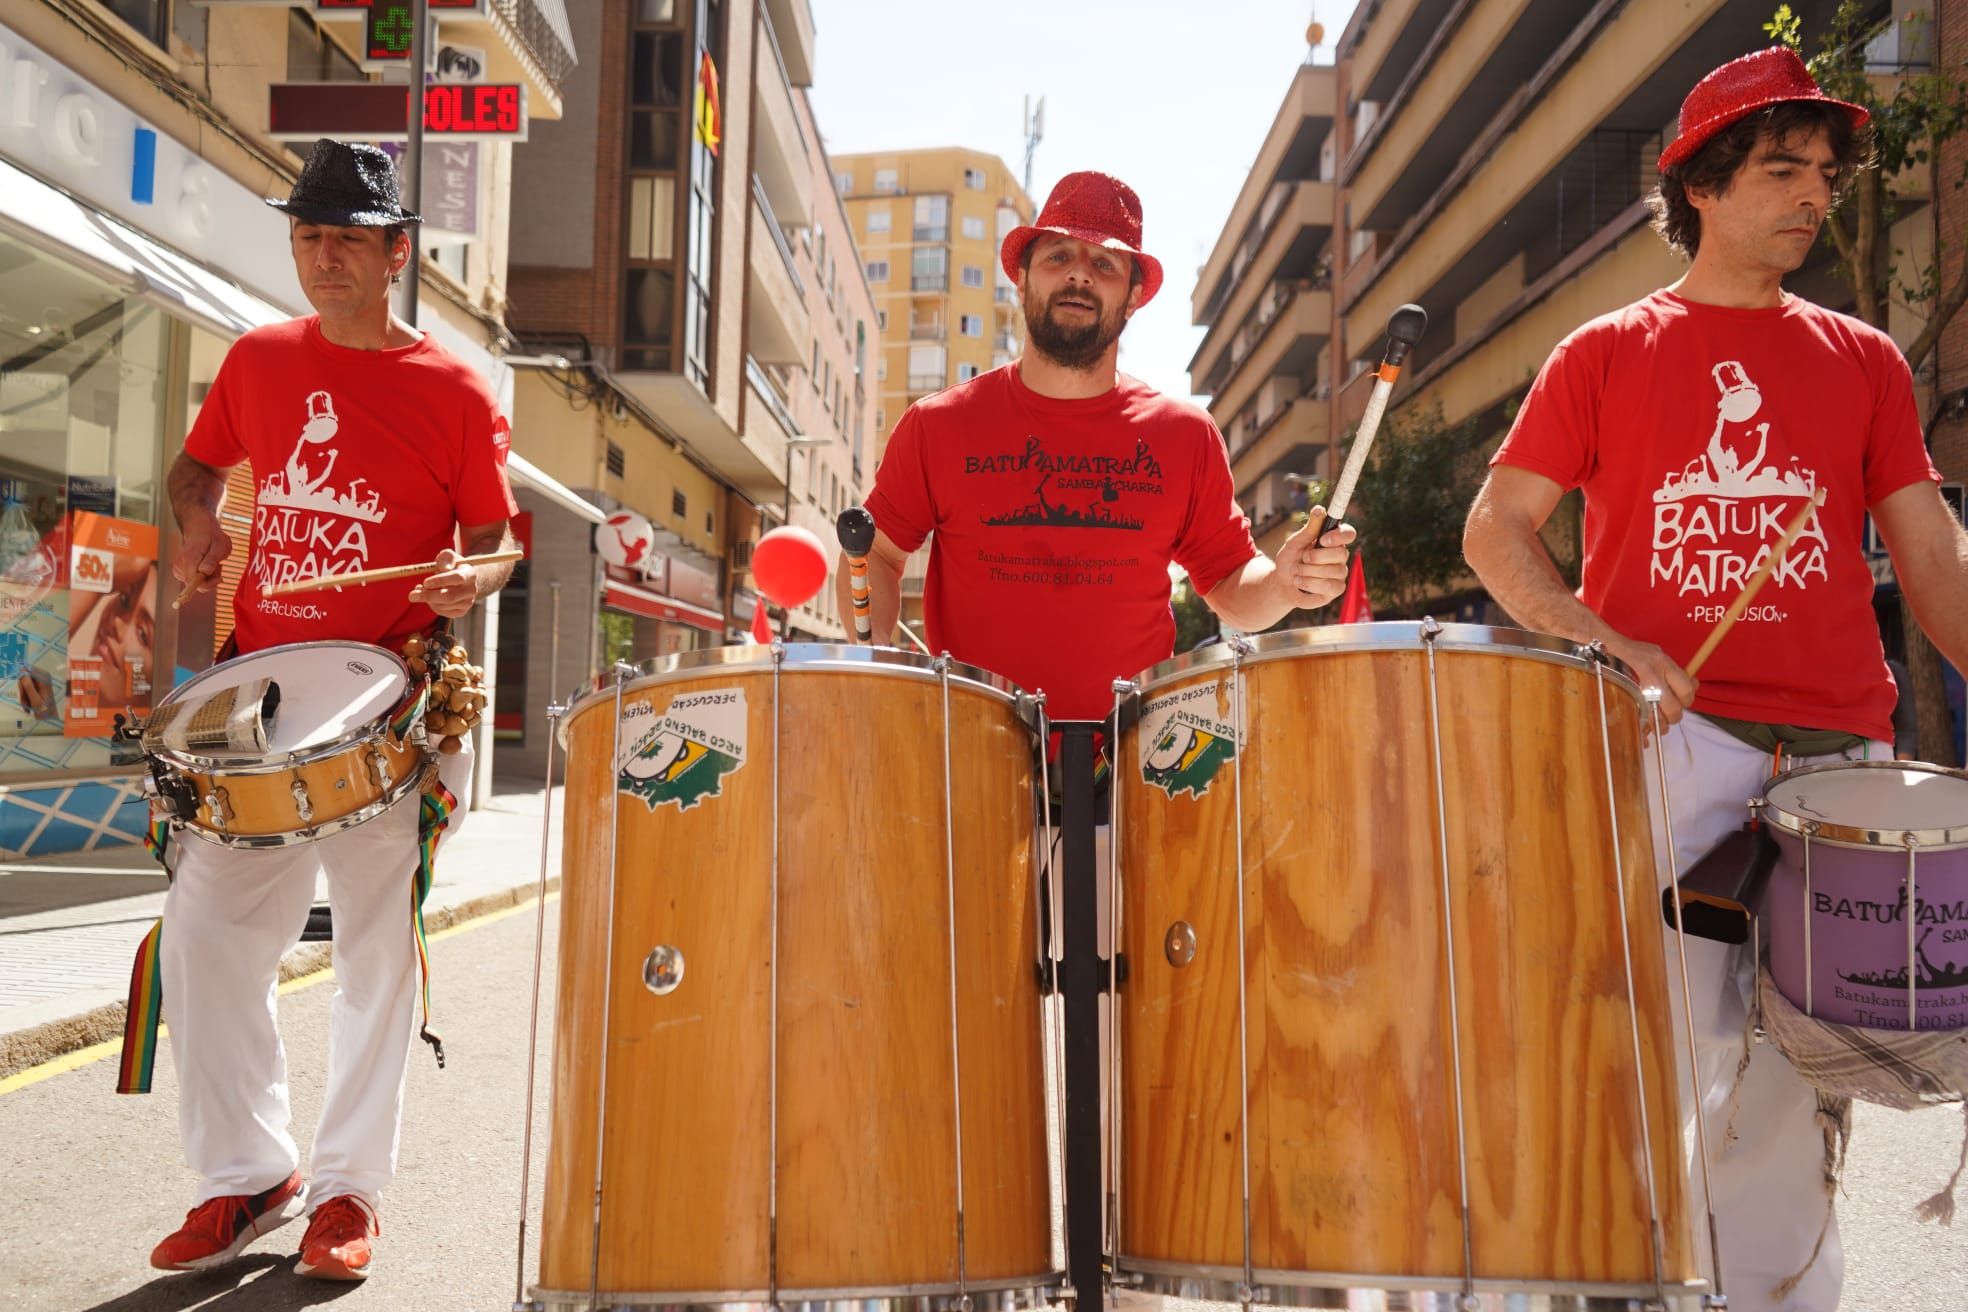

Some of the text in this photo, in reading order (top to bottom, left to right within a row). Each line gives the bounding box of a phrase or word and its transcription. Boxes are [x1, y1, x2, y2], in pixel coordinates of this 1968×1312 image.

[1056, 478, 1164, 496] SAMBA CHARRA
[256, 506, 369, 562] BATUKA
[1652, 497, 1829, 552] BATUKA
[1650, 543, 1828, 598] MATRAKA
